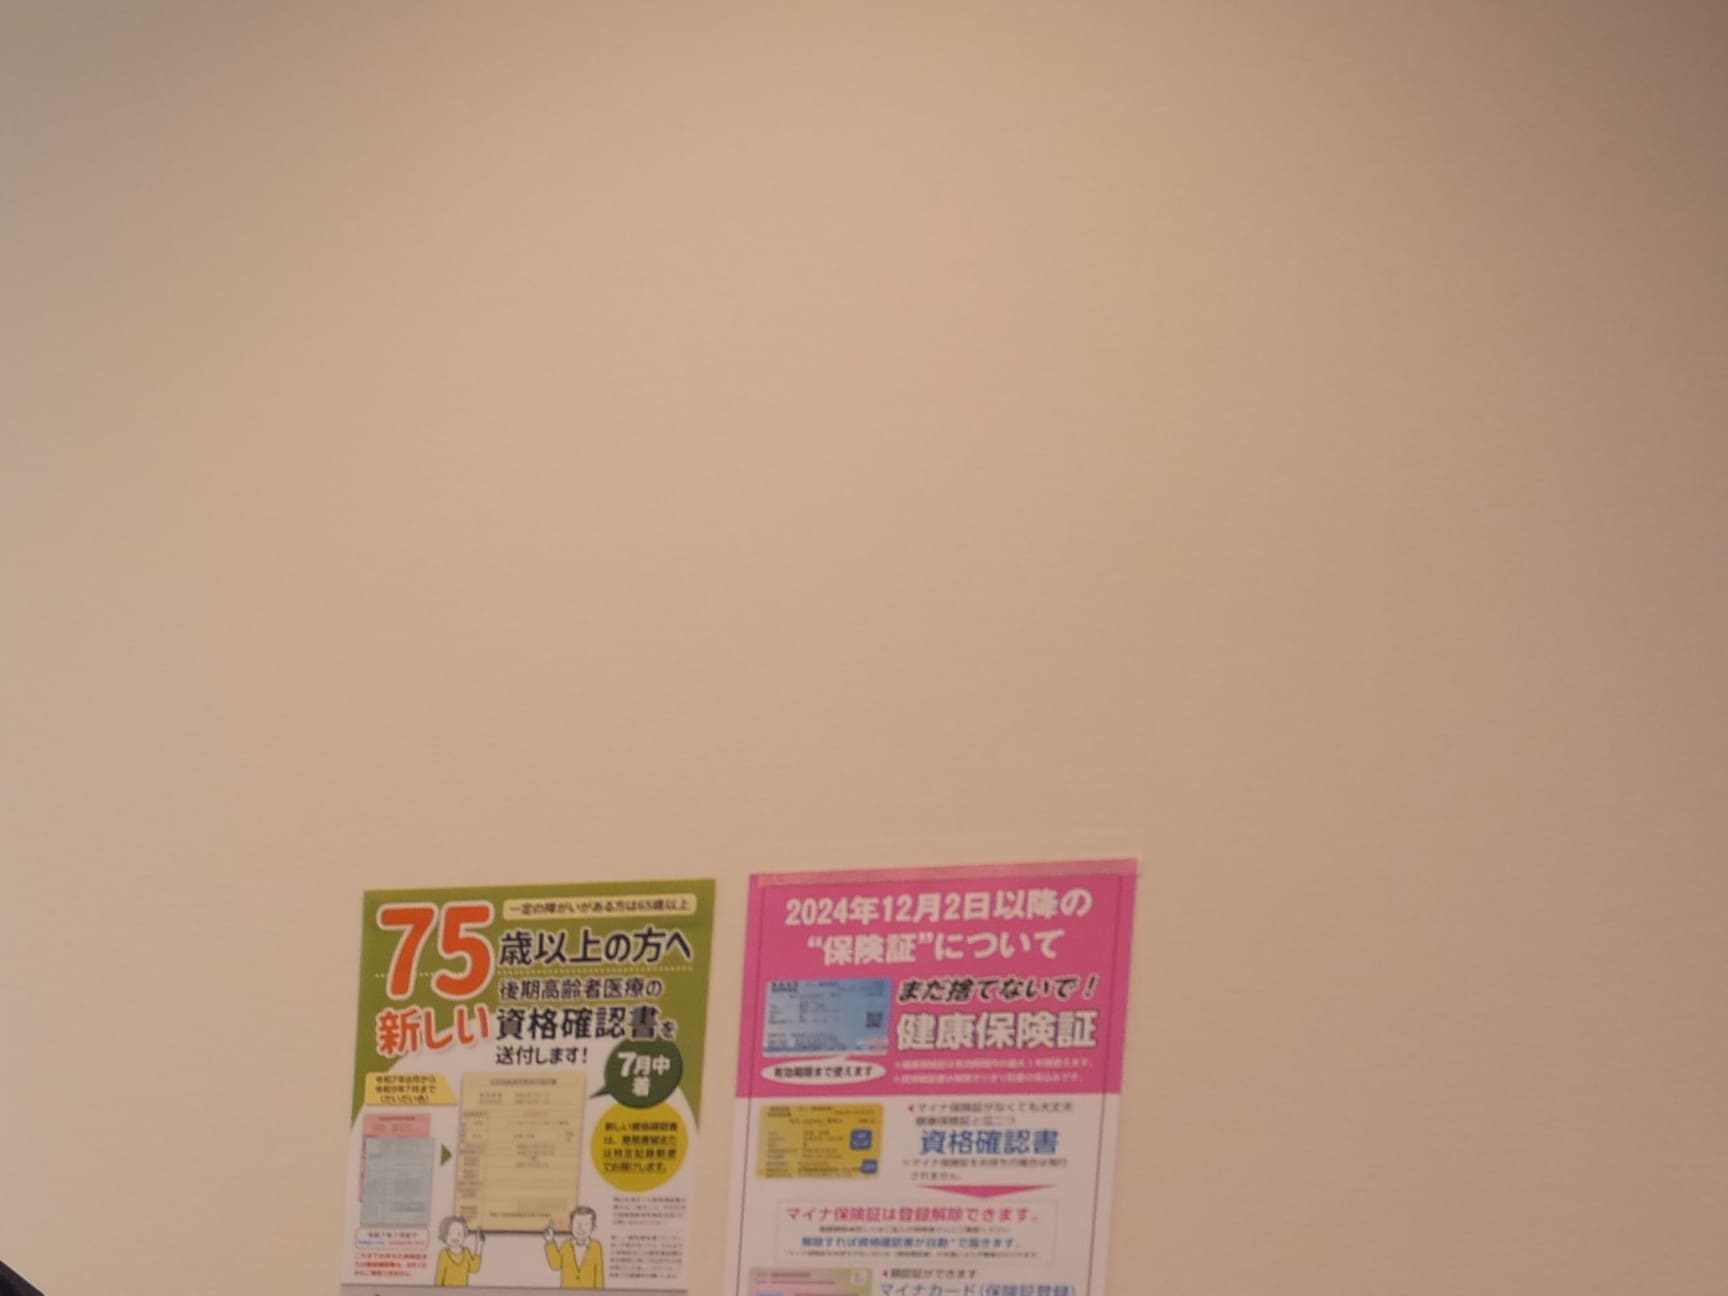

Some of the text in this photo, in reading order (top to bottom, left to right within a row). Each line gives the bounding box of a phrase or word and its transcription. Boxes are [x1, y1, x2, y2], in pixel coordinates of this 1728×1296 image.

[785, 889, 1093, 925] 2024年12月2日以降の
[380, 904, 692, 998] 75 歳以上の方へ
[500, 976, 663, 1001] 後期高齢者医療の
[378, 1005, 677, 1055] 新しい 資格確認書を
[897, 1009, 1099, 1051] 健康保険証
[617, 1051, 671, 1077] 7月中
[773, 1064, 874, 1080] 有効期限まで使えます
[920, 1128, 1059, 1156] 資格確認書
